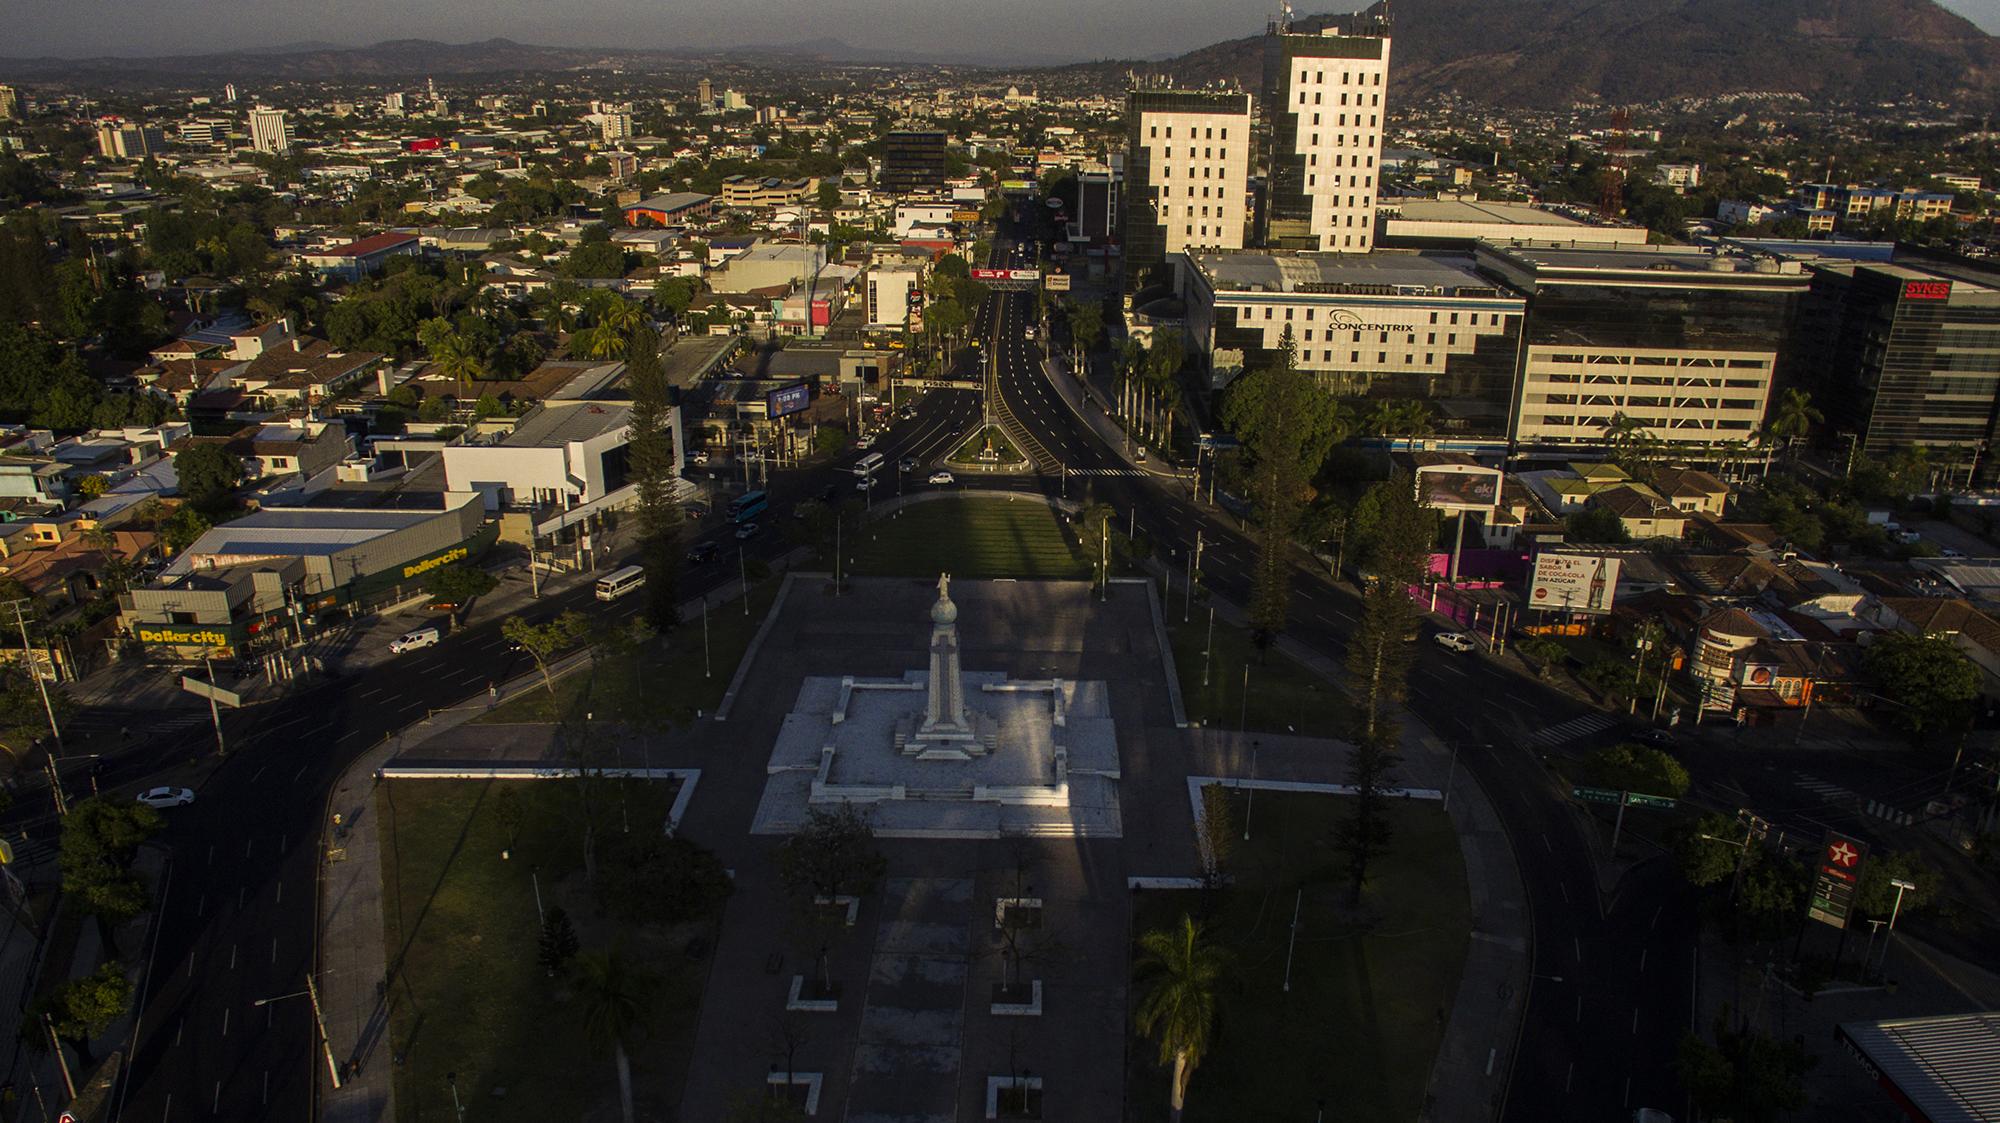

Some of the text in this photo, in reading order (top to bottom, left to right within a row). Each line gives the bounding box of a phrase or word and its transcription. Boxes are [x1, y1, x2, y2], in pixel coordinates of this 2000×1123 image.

[1906, 281, 1949, 294] SYKES
[1329, 322, 1414, 332] CONCENTRIX
[403, 548, 467, 578] Dollarcity
[140, 630, 225, 646] Dollarcity
